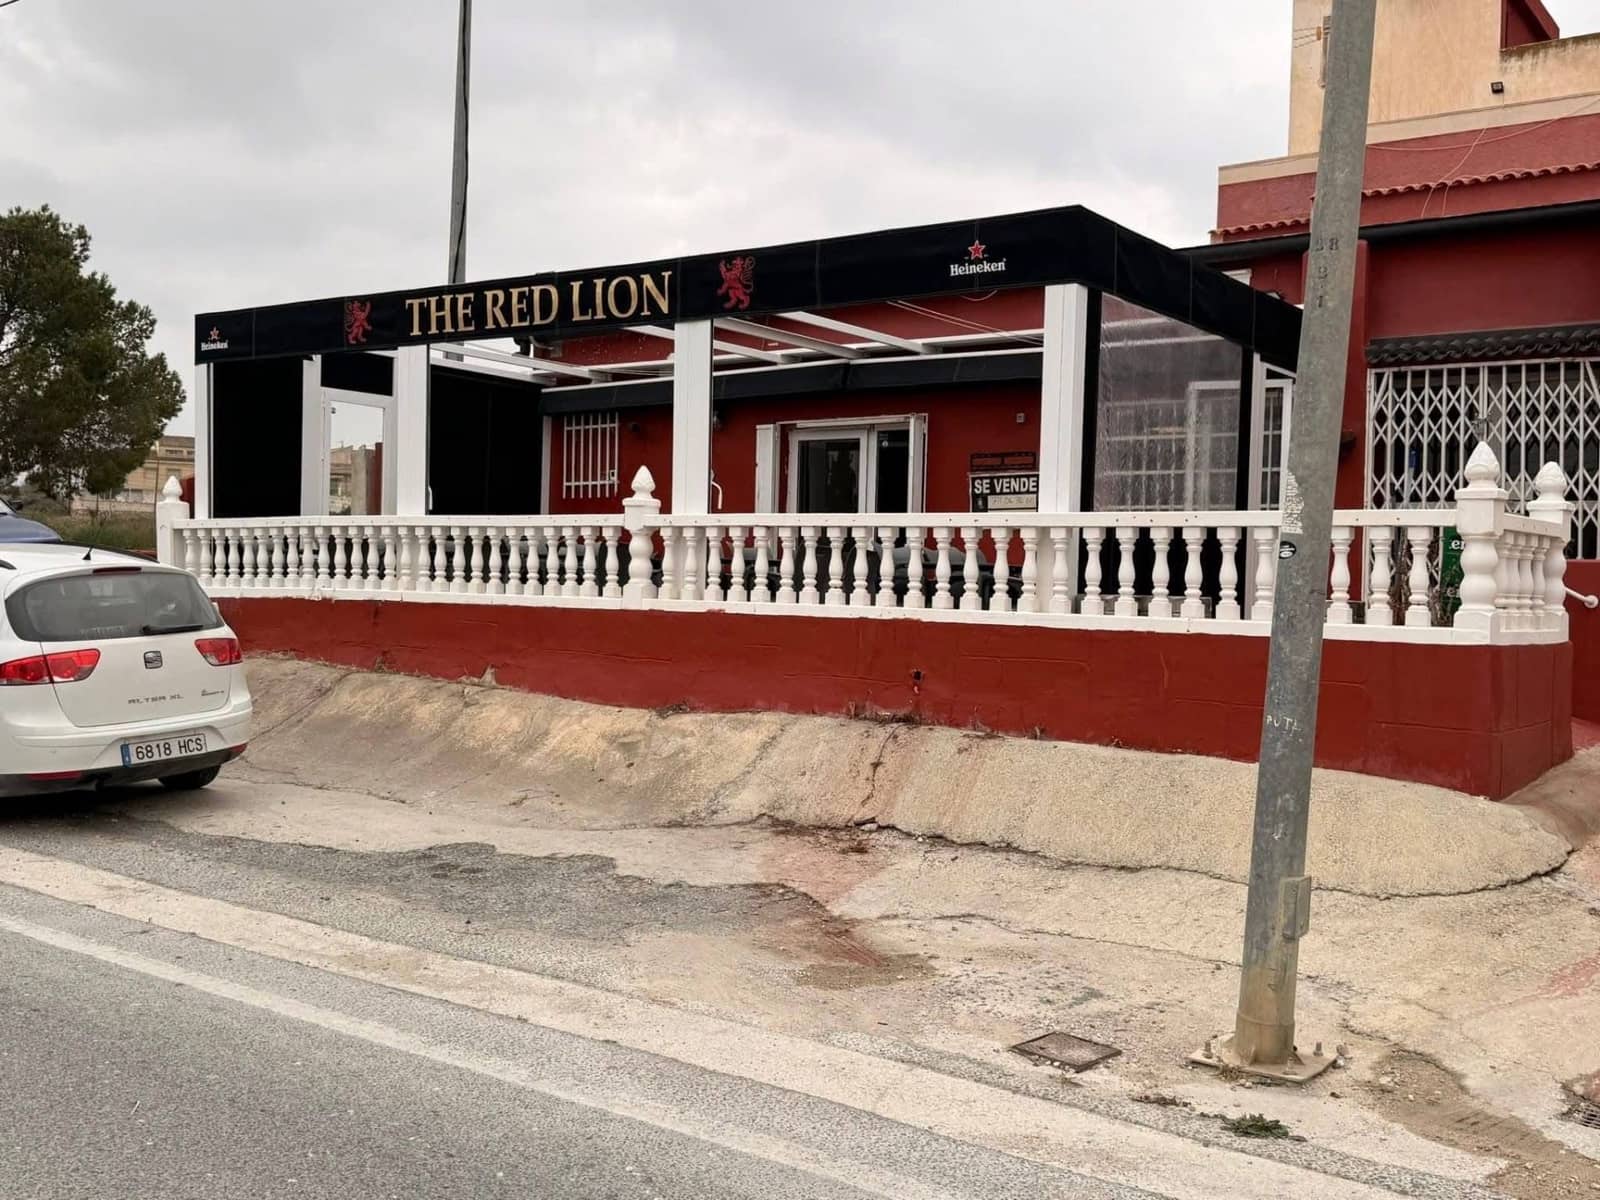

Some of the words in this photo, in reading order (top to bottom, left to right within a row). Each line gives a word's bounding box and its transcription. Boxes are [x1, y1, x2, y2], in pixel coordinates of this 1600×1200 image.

[949, 258, 1006, 276] Heineken
[405, 293, 475, 336] THE
[484, 284, 559, 329] RED
[570, 271, 672, 321] LION
[974, 479, 990, 494] SE
[993, 477, 1037, 493] VENDE
[135, 742, 172, 760] 6818
[178, 737, 203, 754] HCS
